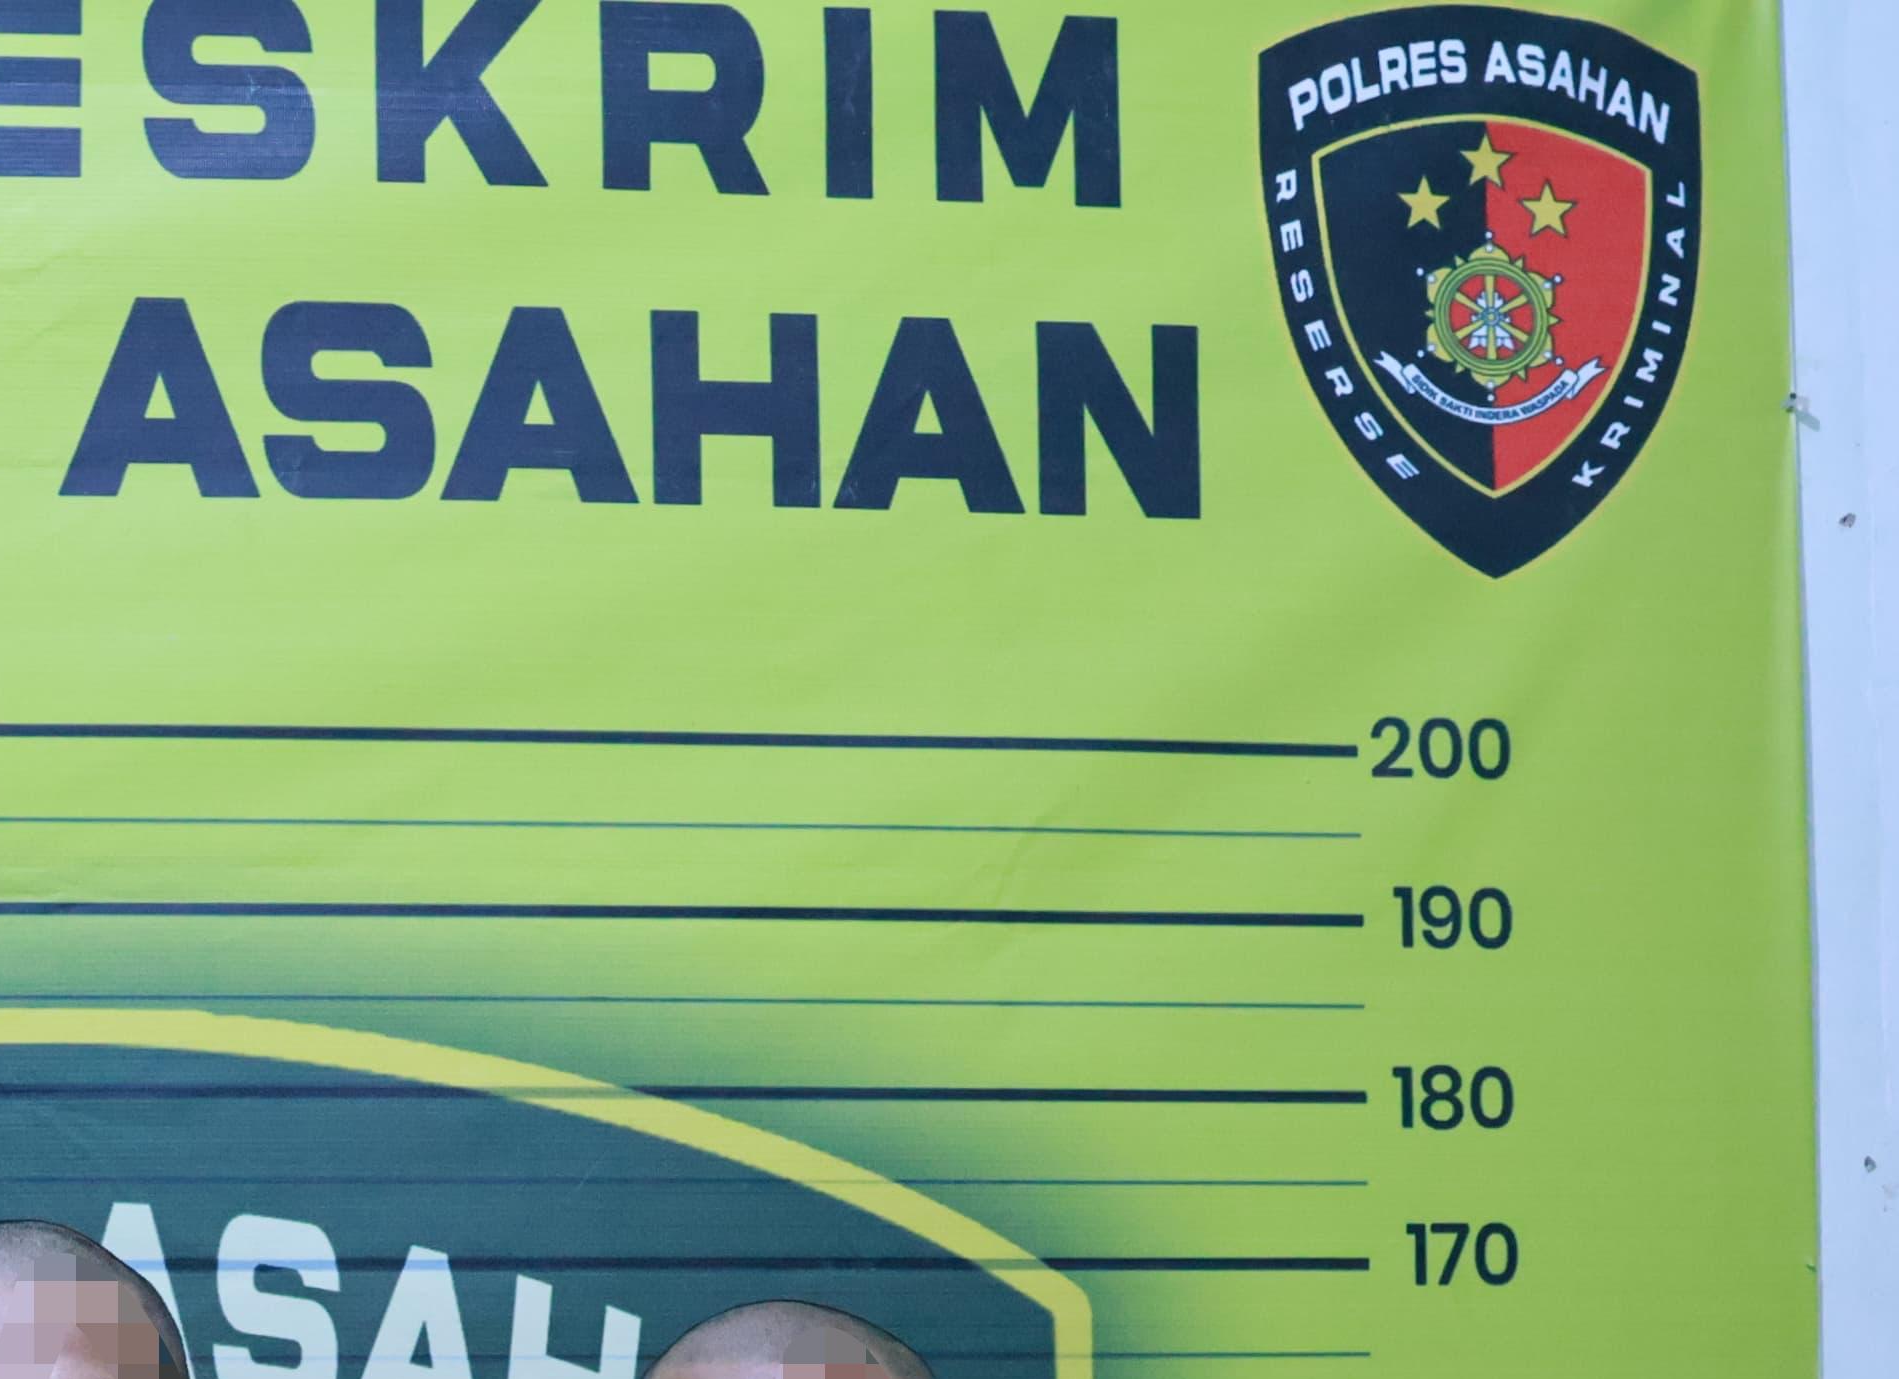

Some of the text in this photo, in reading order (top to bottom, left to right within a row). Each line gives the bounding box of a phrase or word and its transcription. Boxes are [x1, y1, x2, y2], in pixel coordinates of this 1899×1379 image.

[1288, 40, 1670, 143] POLRES ASAHAN
[1275, 169, 1419, 480] RESERSE
[1572, 181, 1685, 487] KRIMINAL
[58, 296, 1201, 519] ASAHAN
[1370, 717, 1511, 780] 200
[1392, 885, 1513, 949] 190
[1392, 1064, 1514, 1130] 180
[1405, 1222, 1519, 1286] 170
